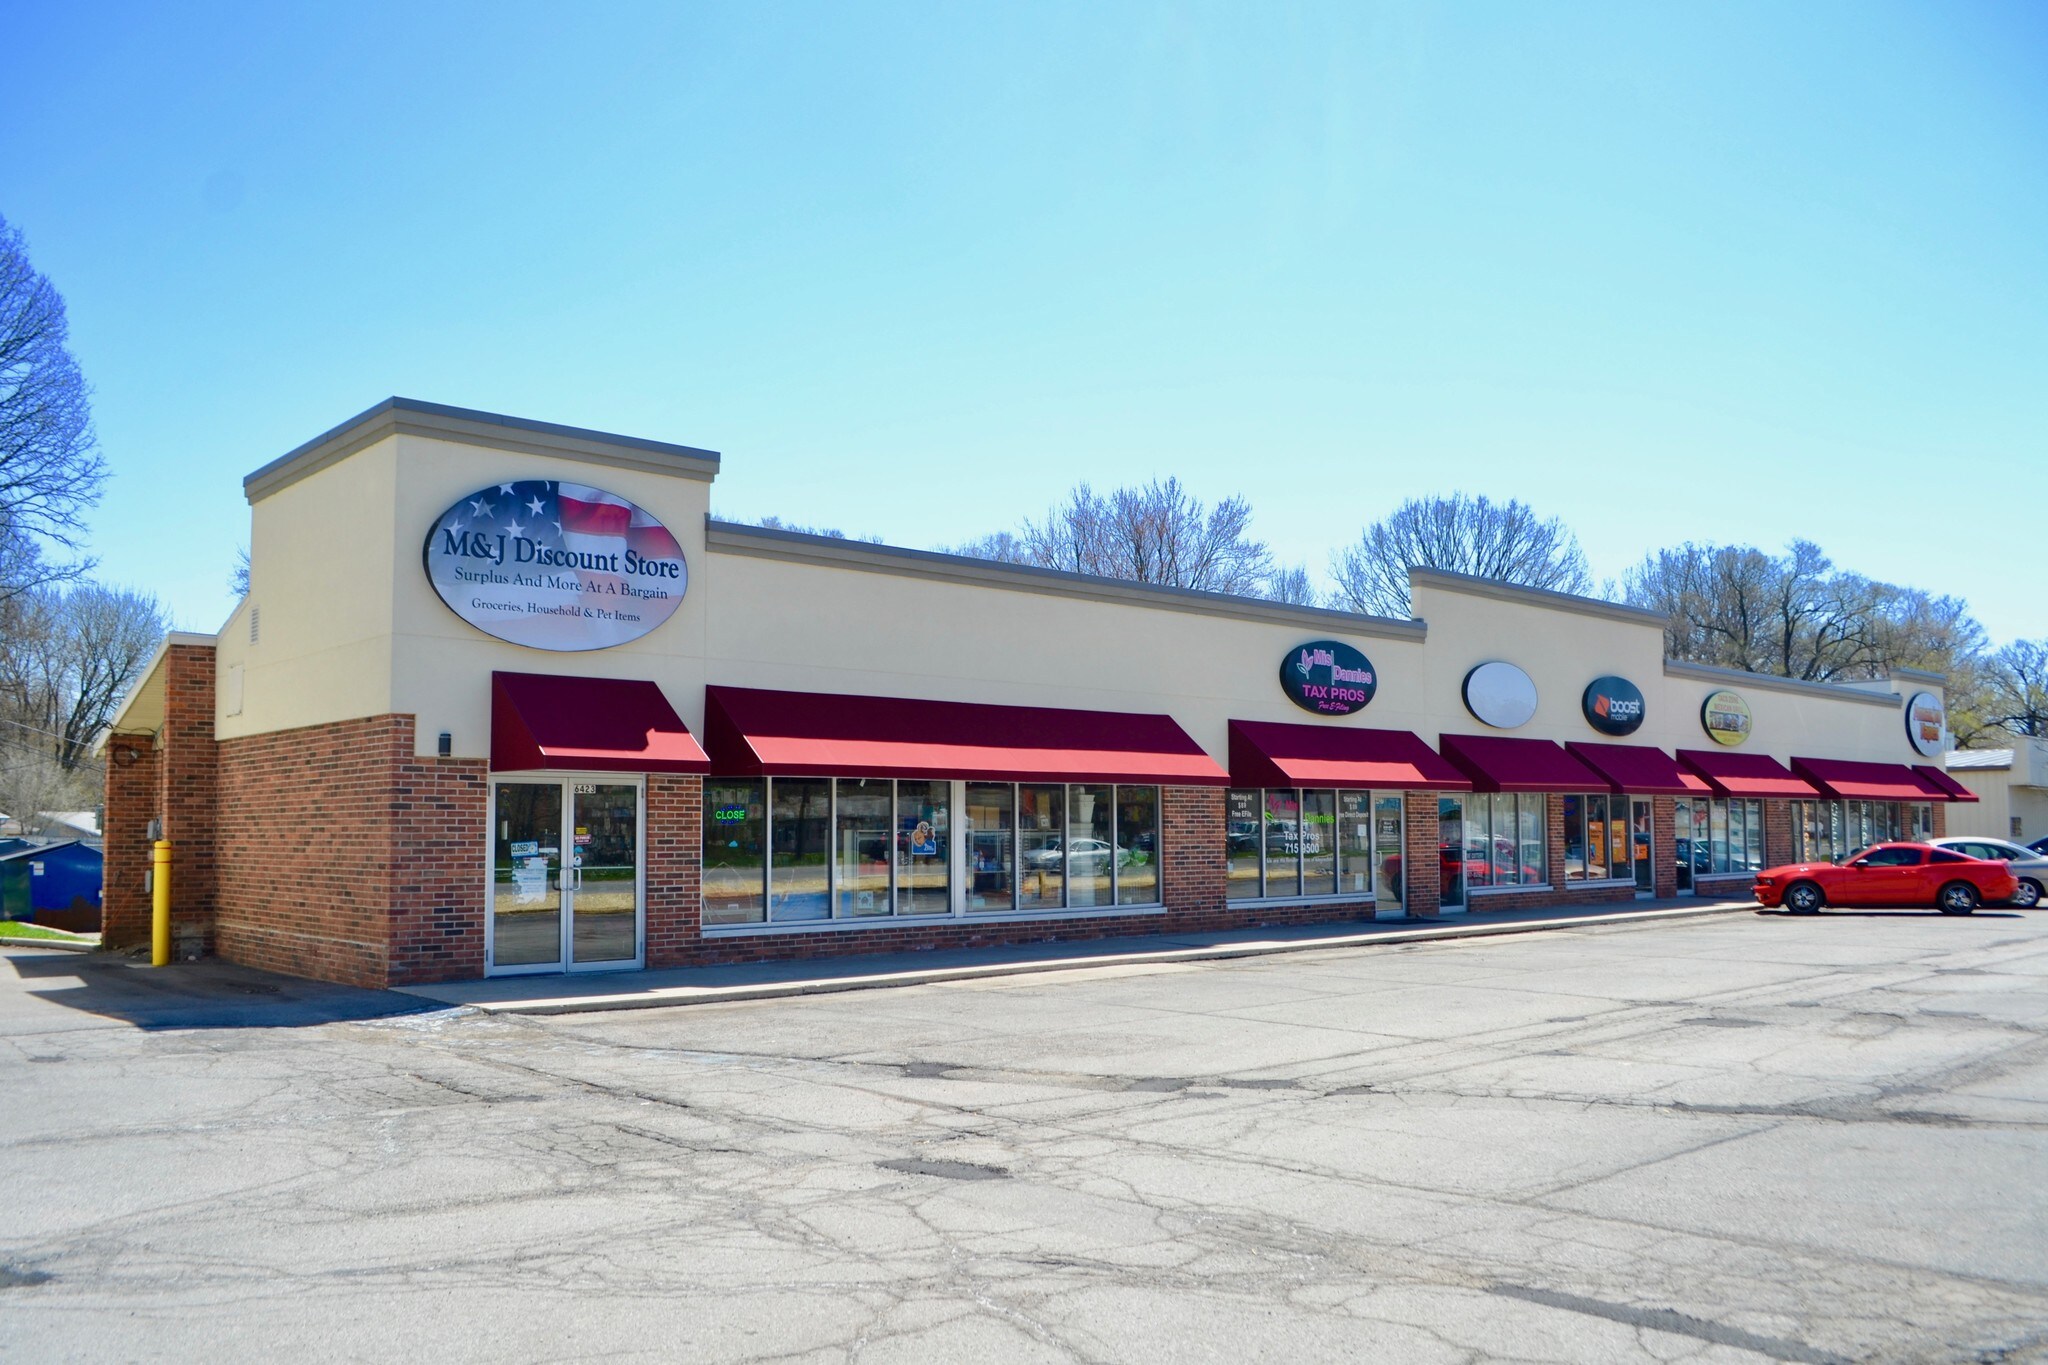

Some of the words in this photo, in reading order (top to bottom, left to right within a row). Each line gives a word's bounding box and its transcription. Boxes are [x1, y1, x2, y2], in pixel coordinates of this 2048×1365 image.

[443, 528, 507, 565] M&J
[514, 536, 618, 573] Discount
[625, 549, 679, 579] Store
[454, 567, 509, 586] Surplus
[513, 574, 543, 588] And
[547, 575, 582, 592] More
[586, 580, 602, 593] At
[605, 581, 617, 595] A
[620, 582, 668, 600] Bargain
[472, 597, 524, 613] Groceries,
[527, 602, 581, 617] Household
[583, 607, 593, 618] &
[597, 608, 612, 620] Pet
[615, 610, 641, 622] Items
[1313, 649, 1332, 667] Mis
[1333, 665, 1372, 685] Dannies
[1302, 684, 1328, 699] TAX
[1331, 688, 1365, 702] PROS
[1610, 697, 1640, 714] boost
[1610, 713, 1628, 721] mobile
[574, 785, 595, 793] 6423
[715, 810, 745, 820] CLOSE
[1283, 830, 1298, 840] Tax
[1301, 831, 1320, 841] Pros
[511, 844, 529, 853] CLOSED
